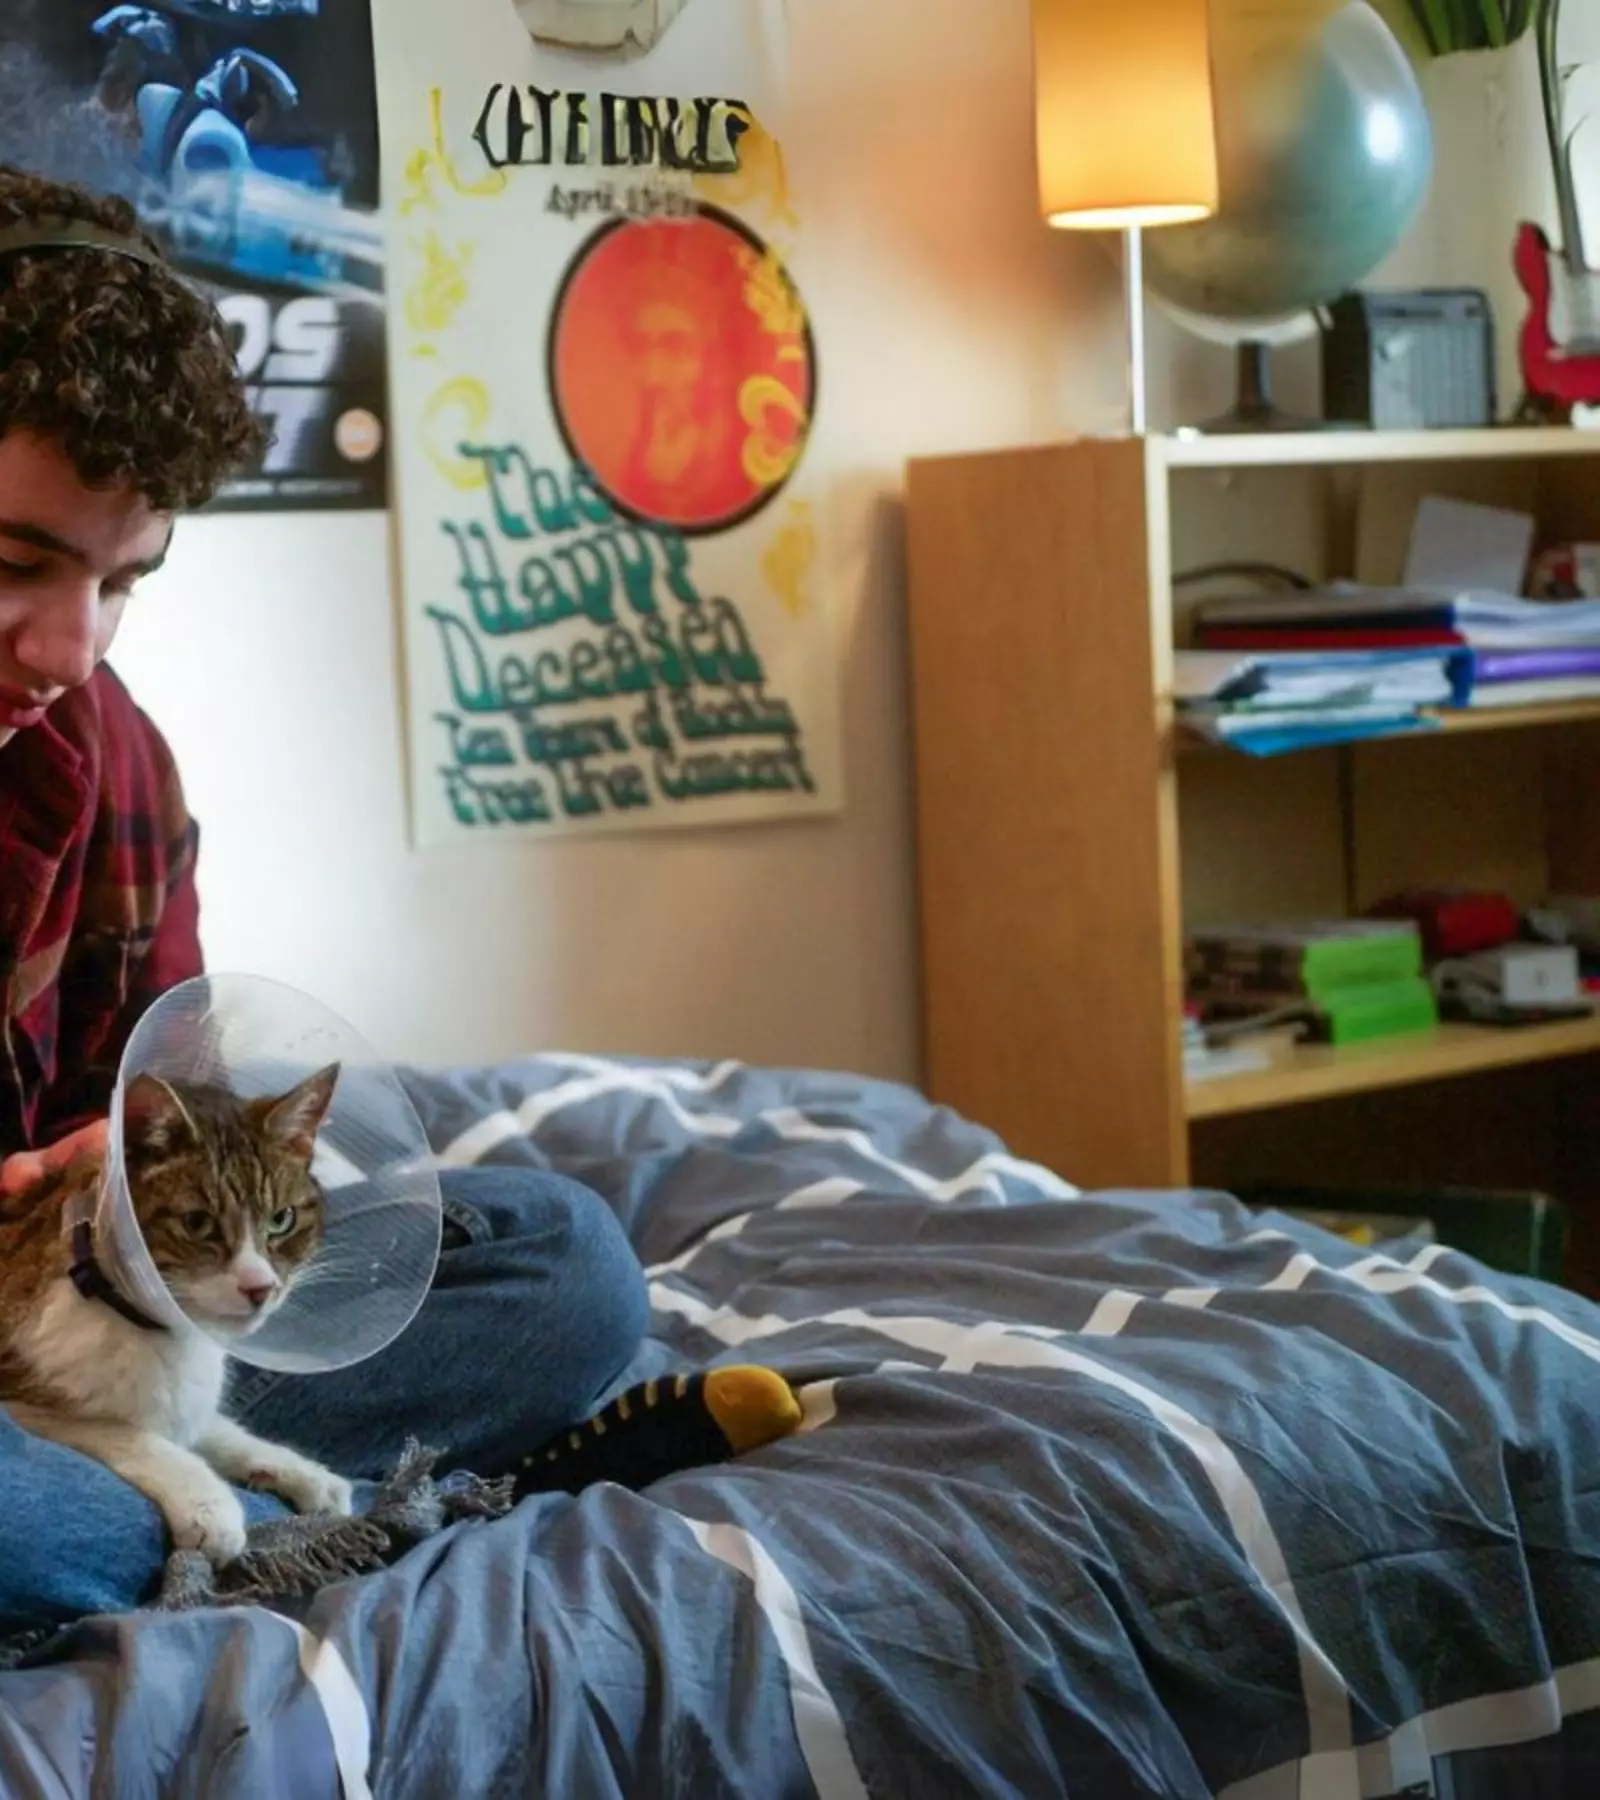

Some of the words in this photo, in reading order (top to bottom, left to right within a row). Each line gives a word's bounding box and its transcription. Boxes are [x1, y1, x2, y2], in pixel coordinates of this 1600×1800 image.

[456, 439, 614, 539] The
[440, 519, 704, 636] Happy
[424, 596, 768, 713] Deceased
